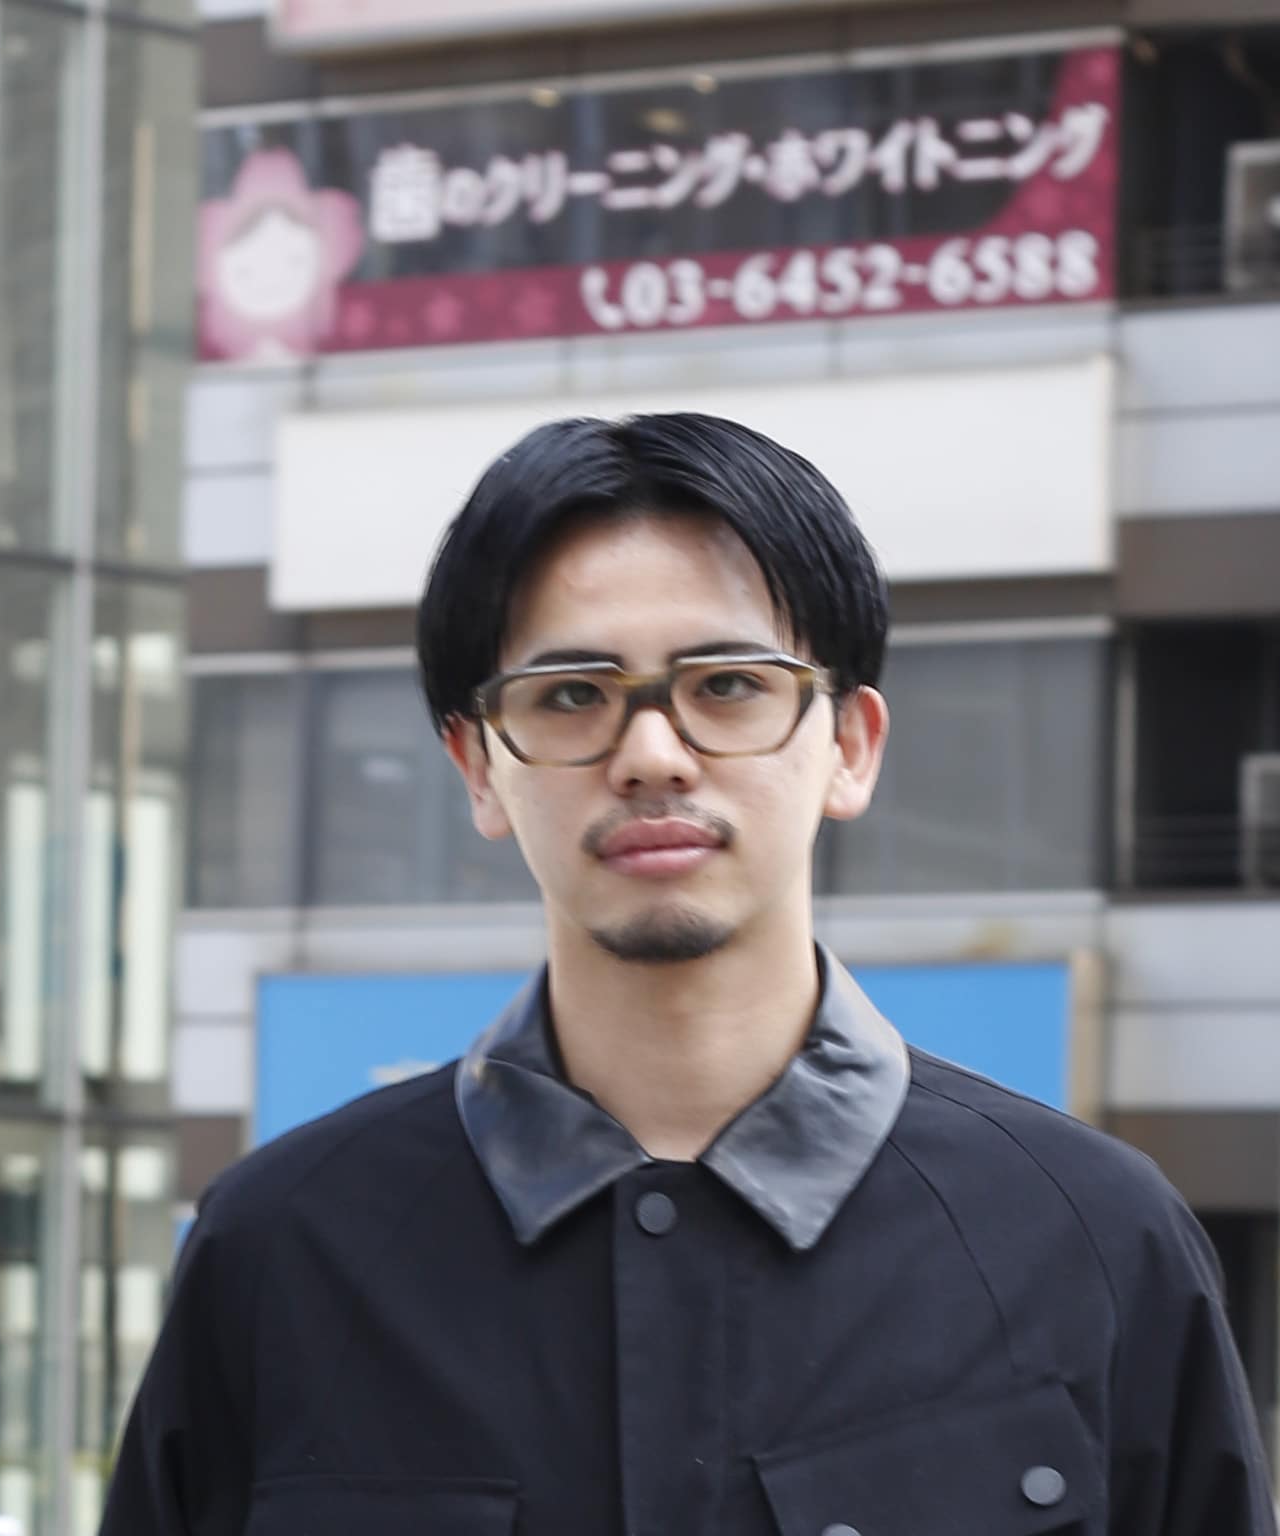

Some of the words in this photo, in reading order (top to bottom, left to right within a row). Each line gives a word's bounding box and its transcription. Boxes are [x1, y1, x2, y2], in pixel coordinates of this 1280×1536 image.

[368, 103, 1108, 242] 歯のクリーニング・ホワイトニング
[620, 230, 1099, 325] 03-6452-6588
